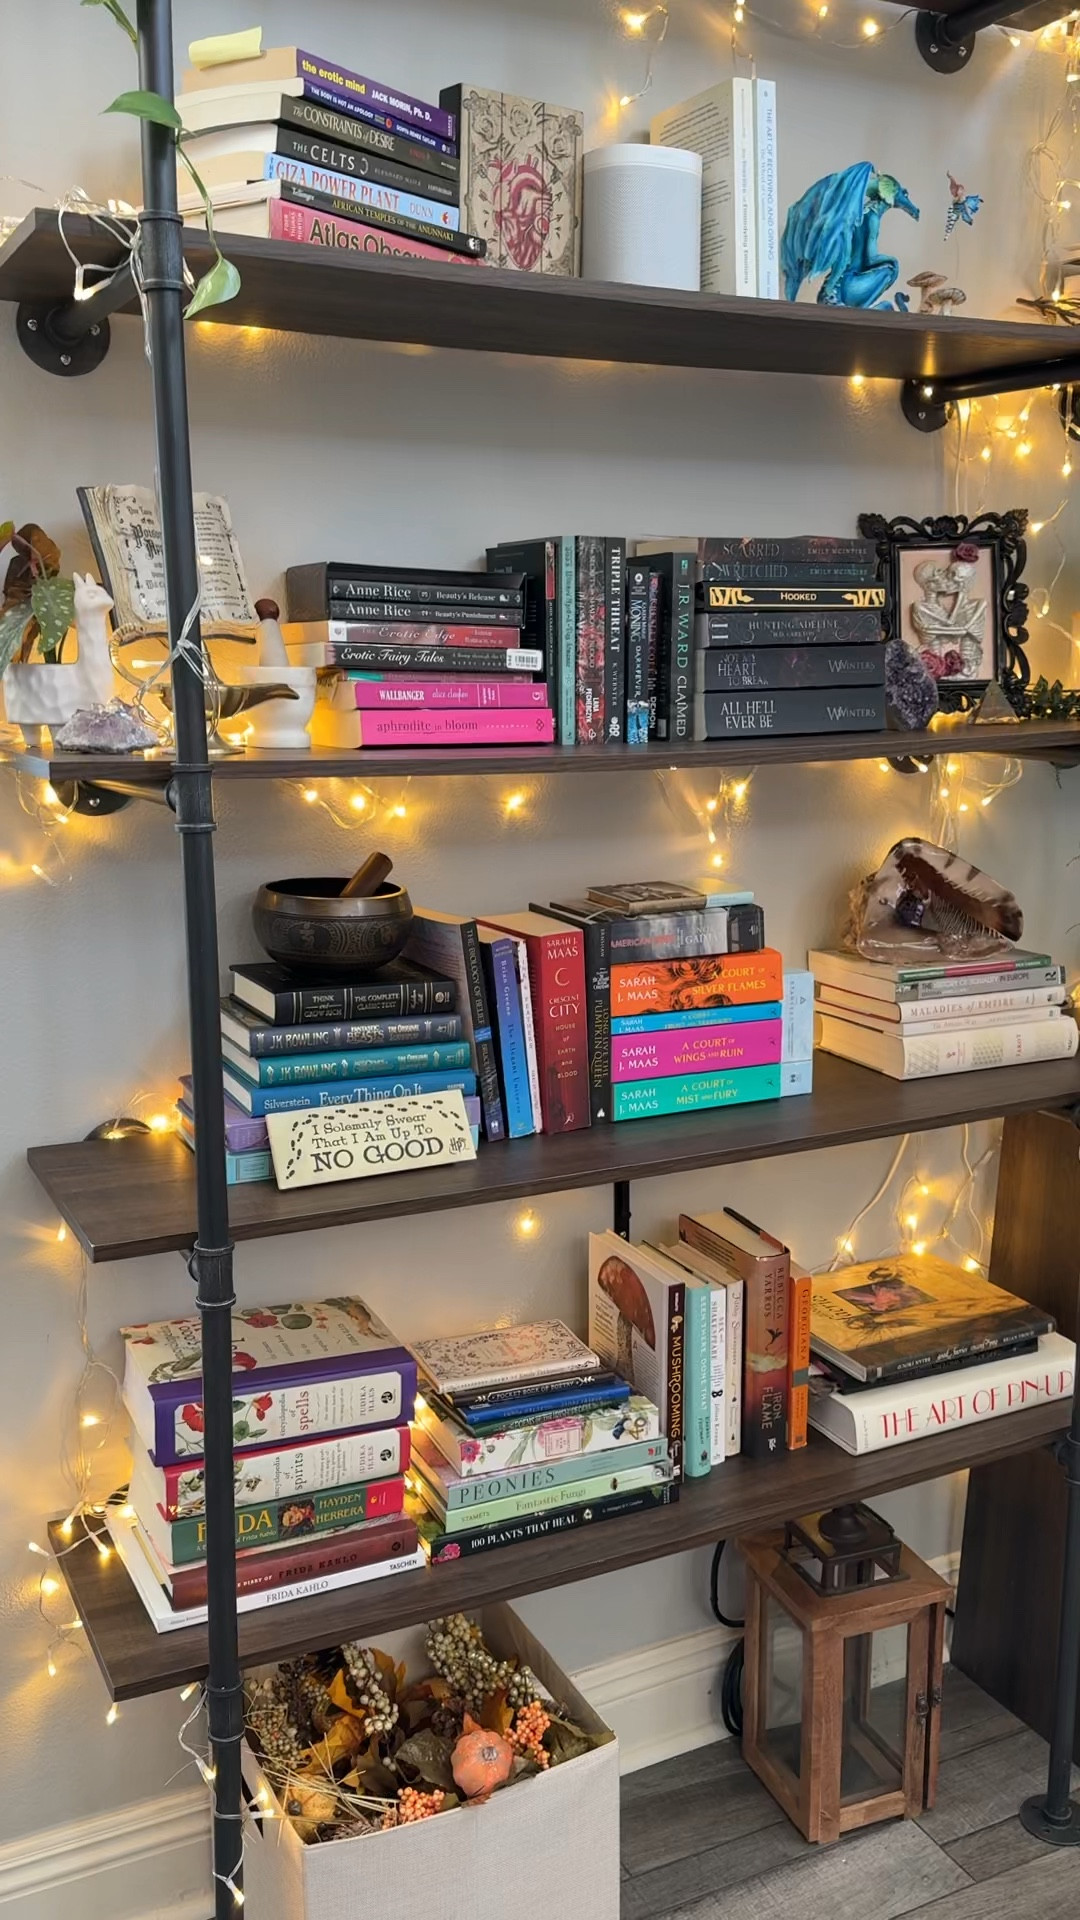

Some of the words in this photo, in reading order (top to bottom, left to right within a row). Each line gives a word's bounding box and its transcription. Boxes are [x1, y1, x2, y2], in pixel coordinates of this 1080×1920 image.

[302, 59, 317, 75] the
[319, 68, 344, 86] erotic
[345, 78, 366, 95] mind
[372, 89, 389, 104] JACK
[424, 112, 432, 122] D.
[304, 106, 362, 140] CONSTRAINTS
[370, 131, 395, 151] DESIRE
[292, 141, 308, 154] THE
[310, 144, 355, 171] CELTS
[276, 161, 307, 188] GIZA
[312, 170, 357, 200] POWER
[360, 185, 400, 212] PLANT
[332, 199, 364, 217] AFRICAN
[364, 209, 396, 225] TEMPLES
[410, 202, 433, 218] DUNN
[310, 216, 359, 250] Atlas
[611, 547, 621, 595] TRIPLE
[346, 584, 382, 598] Anne
[384, 584, 412, 598] Rice
[436, 592, 467, 601] Beauty's
[677, 584, 690, 612] J.R.
[780, 592, 817, 601] HOOKED
[346, 603, 382, 616] Anne
[384, 604, 412, 617] Rice
[610, 598, 620, 652] THREAT
[630, 600, 642, 642] MONING
[749, 620, 795, 631] HUNTING
[798, 620, 839, 631] ADELINE
[378, 626, 420, 640] Erotic
[424, 627, 456, 642] Edge
[677, 612, 690, 669] WARD
[341, 647, 375, 663] Erotic
[378, 649, 411, 665] Fairy
[414, 650, 444, 664] Tales
[634, 646, 642, 699] DARKFEVER
[718, 663, 756, 677] HEART
[380, 690, 425, 701] WALLBANGER
[674, 675, 688, 736] CLAIMED
[721, 702, 743, 716] ALL
[746, 700, 777, 715] HE'LL
[376, 720, 432, 736] aphrodite
[445, 720, 478, 731] bloom
[726, 716, 757, 729] EVER
[760, 715, 774, 728] BE
[466, 928, 474, 944] THE
[547, 938, 572, 948] SARAH
[610, 938, 651, 948] AMERICAN
[548, 946, 579, 960] MAAS
[468, 944, 481, 985] BIOLOGY
[619, 976, 656, 988] SARAH
[710, 970, 720, 979] A
[720, 968, 755, 978] COURT
[922, 982, 933, 990] THE
[1006, 972, 1030, 982] EUROPE
[474, 986, 482, 997] OF
[692, 984, 725, 995] SILVER
[727, 980, 766, 992] FLAMES
[312, 995, 334, 1003] THINK
[368, 994, 400, 1002] COMPLETE
[382, 1001, 396, 1009] TEXT
[503, 986, 512, 1016] Greene
[617, 992, 624, 1003] J.
[627, 990, 658, 1001] MAAS
[476, 997, 485, 1024] BELIEF
[550, 1003, 580, 1019] CITY
[910, 1004, 962, 1018] MALADIES
[556, 1022, 576, 1032] HOUSE
[594, 1000, 602, 1049] PUMPKIN
[270, 1034, 284, 1050] JK
[286, 1031, 328, 1048] ROWLING
[347, 1030, 384, 1043] BEASTS
[682, 1042, 689, 1051] A
[693, 1038, 728, 1050] COURT
[509, 1040, 518, 1073] Elegant
[622, 1046, 656, 1058] SARAH
[674, 1052, 706, 1065] WINGS
[720, 1048, 744, 1058] RUIN
[294, 1063, 338, 1080] ROWLING
[591, 1050, 602, 1088] QUEEN
[619, 1062, 624, 1072] J.
[628, 1058, 658, 1070] MAAS
[558, 1070, 578, 1079] BLOOD
[681, 1084, 688, 1093] A
[692, 1078, 726, 1091] COURT
[320, 1087, 354, 1107] Every
[354, 1084, 390, 1101] Thing
[392, 1082, 412, 1097] On
[414, 1082, 422, 1094] It
[622, 1088, 656, 1101] SARAH
[676, 1094, 699, 1105] MIST
[714, 1089, 738, 1100] FURY
[264, 1097, 310, 1110] Silverstein
[619, 1105, 624, 1115] J.
[628, 1100, 658, 1112] MAAS
[312, 1124, 318, 1136] I
[324, 1119, 382, 1135] Solemnly
[386, 1113, 428, 1127] Swear
[312, 1136, 348, 1150] That
[352, 1133, 358, 1144] I
[364, 1132, 386, 1143] Am
[390, 1128, 411, 1142] Up
[414, 1124, 434, 1136] To
[310, 1150, 354, 1174] NO
[364, 1137, 444, 1164] GOOD
[764, 1272, 772, 1318] YARROS
[800, 1288, 809, 1362] GEORGIANA
[670, 1336, 683, 1439] MUSHROOMING
[296, 1390, 314, 1431] spells
[762, 1386, 773, 1430] FLAME
[774, 1392, 782, 1420] IRON
[880, 1406, 920, 1439] THE
[926, 1394, 966, 1425] ART
[973, 1384, 1000, 1415] OF
[1008, 1370, 1074, 1406] PIN-UP
[283, 1472, 290, 1480] of
[291, 1452, 307, 1491] spirits
[460, 1467, 556, 1504] PEONIES
[319, 1492, 362, 1508] HAYDEN
[516, 1492, 560, 1512] Fantastic
[560, 1488, 586, 1503] Fungi
[316, 1506, 364, 1524] HERRERA
[462, 1511, 490, 1523] STAMETS
[471, 1537, 485, 1549] 100
[487, 1526, 524, 1546] PLANTS
[525, 1521, 551, 1538] THAT
[552, 1514, 578, 1530] HEAL
[278, 1566, 314, 1580] FRIDA
[318, 1553, 358, 1570] KAHLO
[390, 1559, 418, 1571] TASCHEN
[244, 1577, 262, 1587] DIARY
[266, 1587, 295, 1604] FRIDA
[296, 1580, 329, 1596] KAHLO
